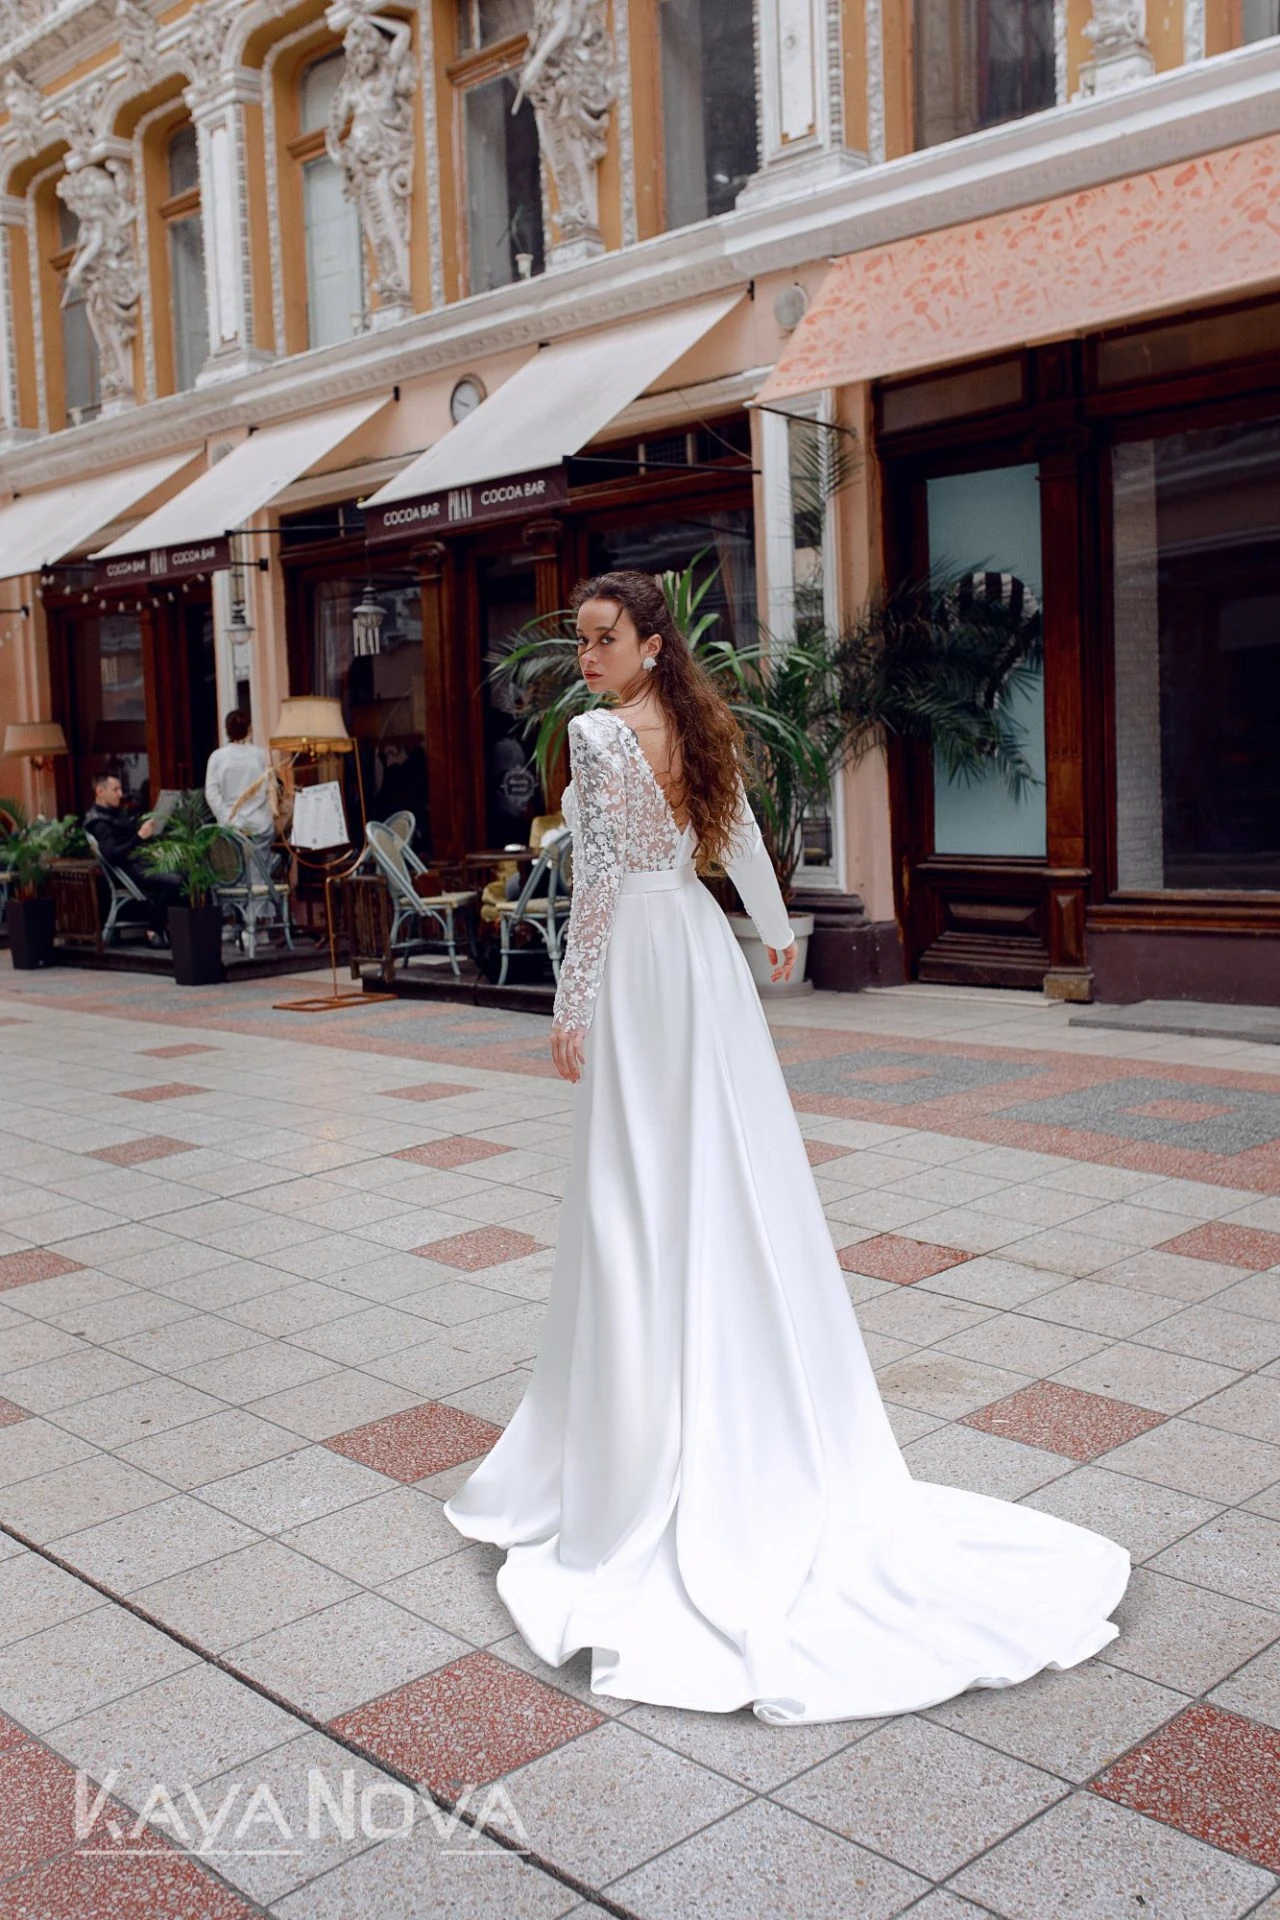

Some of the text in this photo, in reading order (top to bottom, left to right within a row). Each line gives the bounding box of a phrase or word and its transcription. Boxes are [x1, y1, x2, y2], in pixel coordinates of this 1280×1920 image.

[481, 485, 523, 506] COCOA
[524, 480, 546, 497] BAR
[383, 507, 420, 526] COCOA
[420, 502, 440, 519] BAR
[172, 550, 200, 566] COCOA
